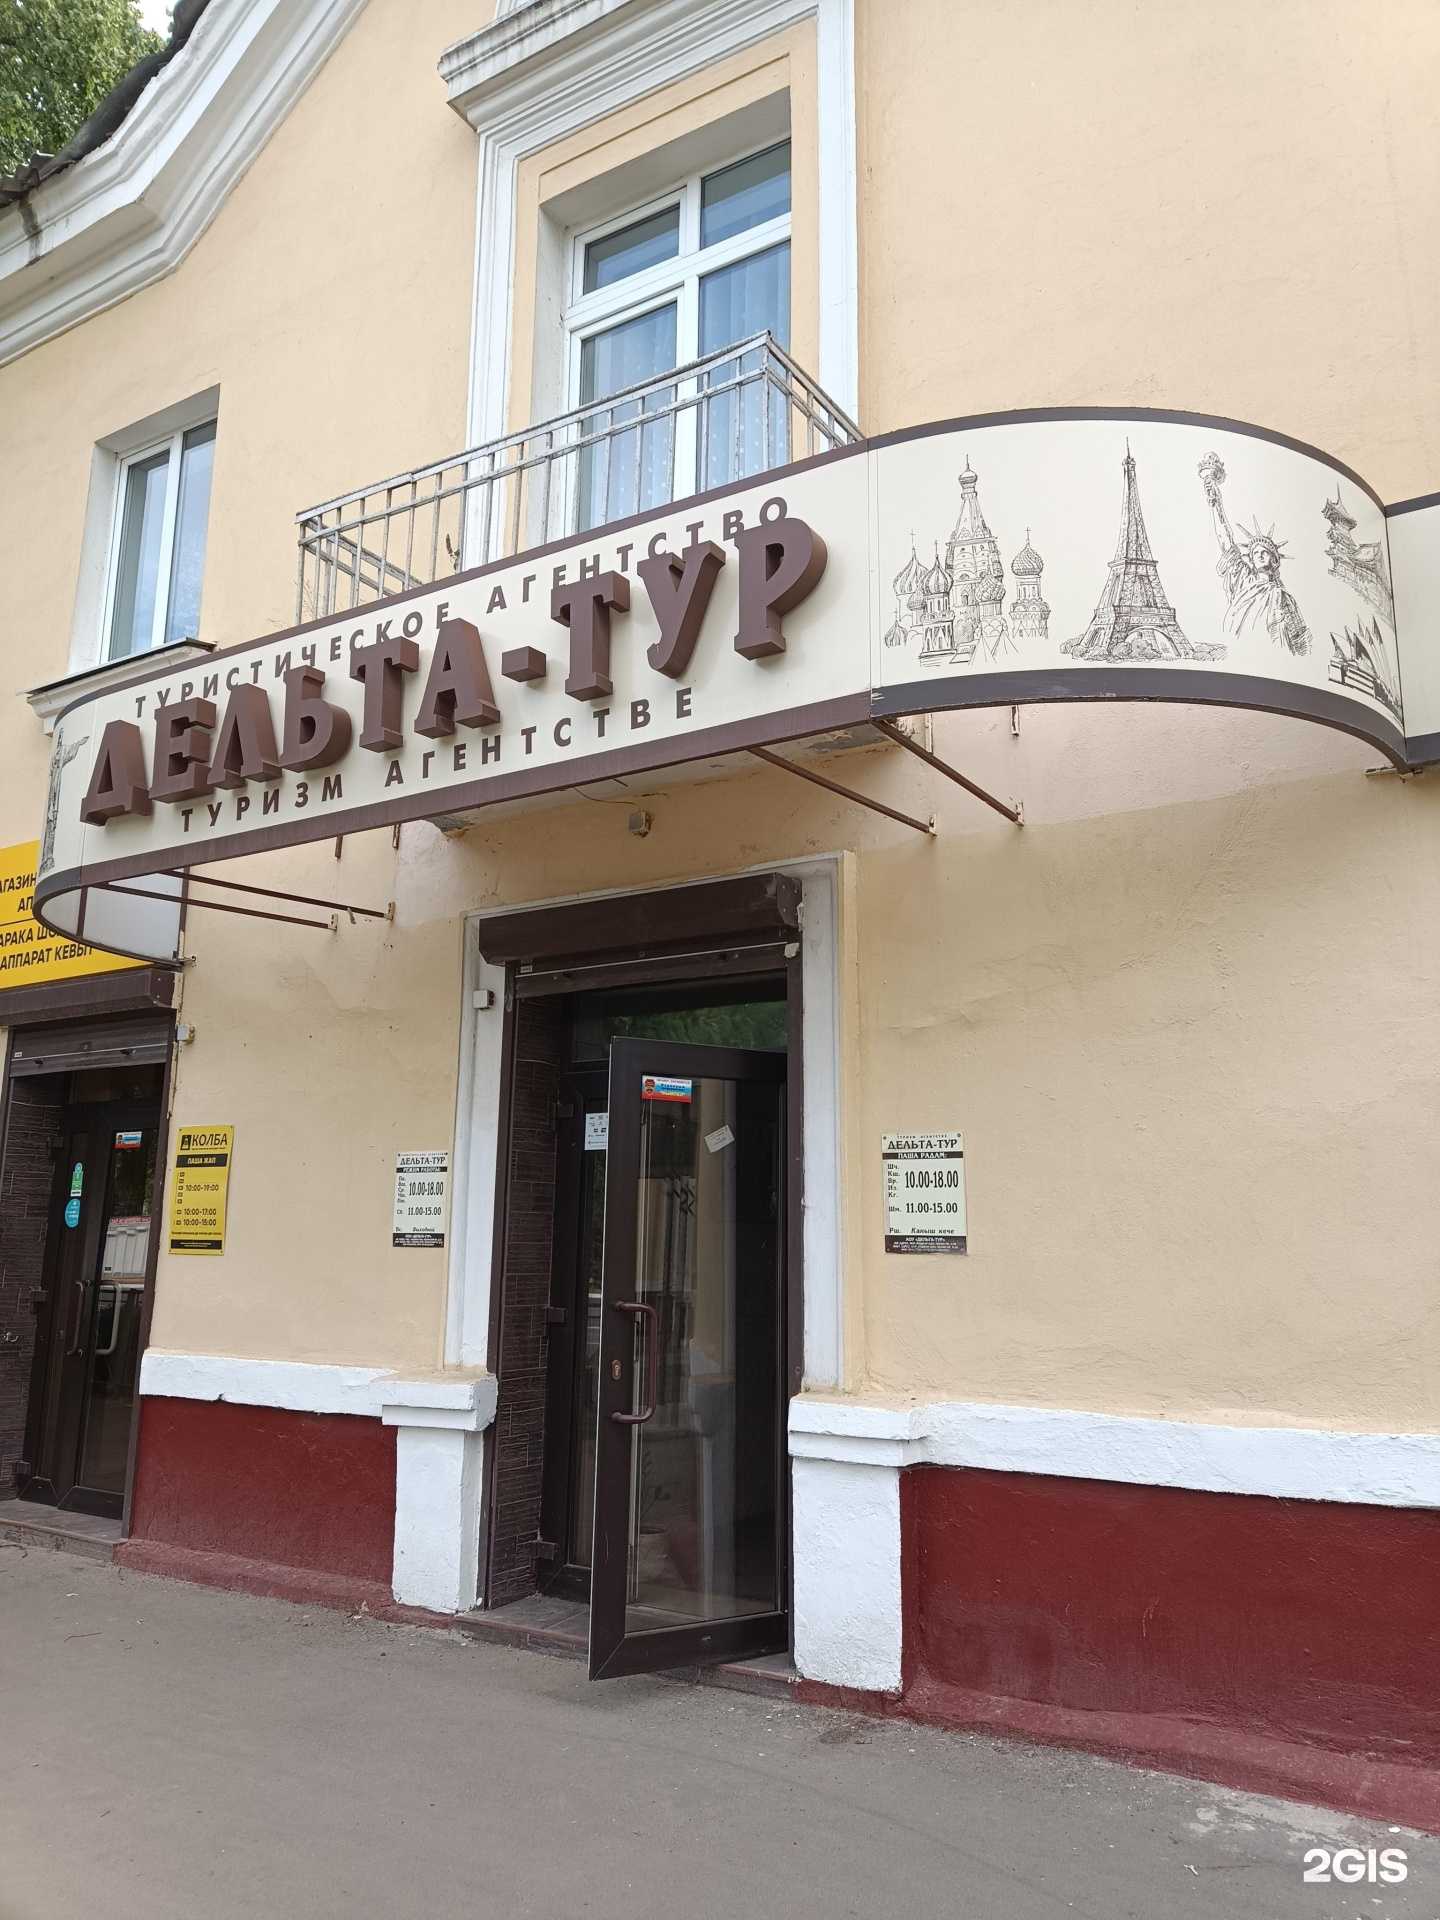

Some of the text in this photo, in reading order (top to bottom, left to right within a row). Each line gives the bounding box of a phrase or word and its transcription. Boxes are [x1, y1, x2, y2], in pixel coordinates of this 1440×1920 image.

[136, 496, 788, 718] ТУРИСТИЧЕСКОЕ АГЕНТСТВО
[80, 517, 828, 827] ДЕЛЬТА-ТУР
[181, 688, 693, 832] ТУРИЗМ АГЕНТСТВЕ
[192, 1133, 228, 1146] КОЛБА
[888, 1139, 957, 1150] ДЕЛЬТА-ТУР
[400, 1157, 446, 1165] ДЕЛЬТА-ТУР
[905, 1170, 959, 1188] 10.00-18.00
[409, 1181, 444, 1196] 10.00-18.00
[408, 1206, 442, 1216] 11.00-15.00
[906, 1202, 958, 1213] 11.00-15.00
